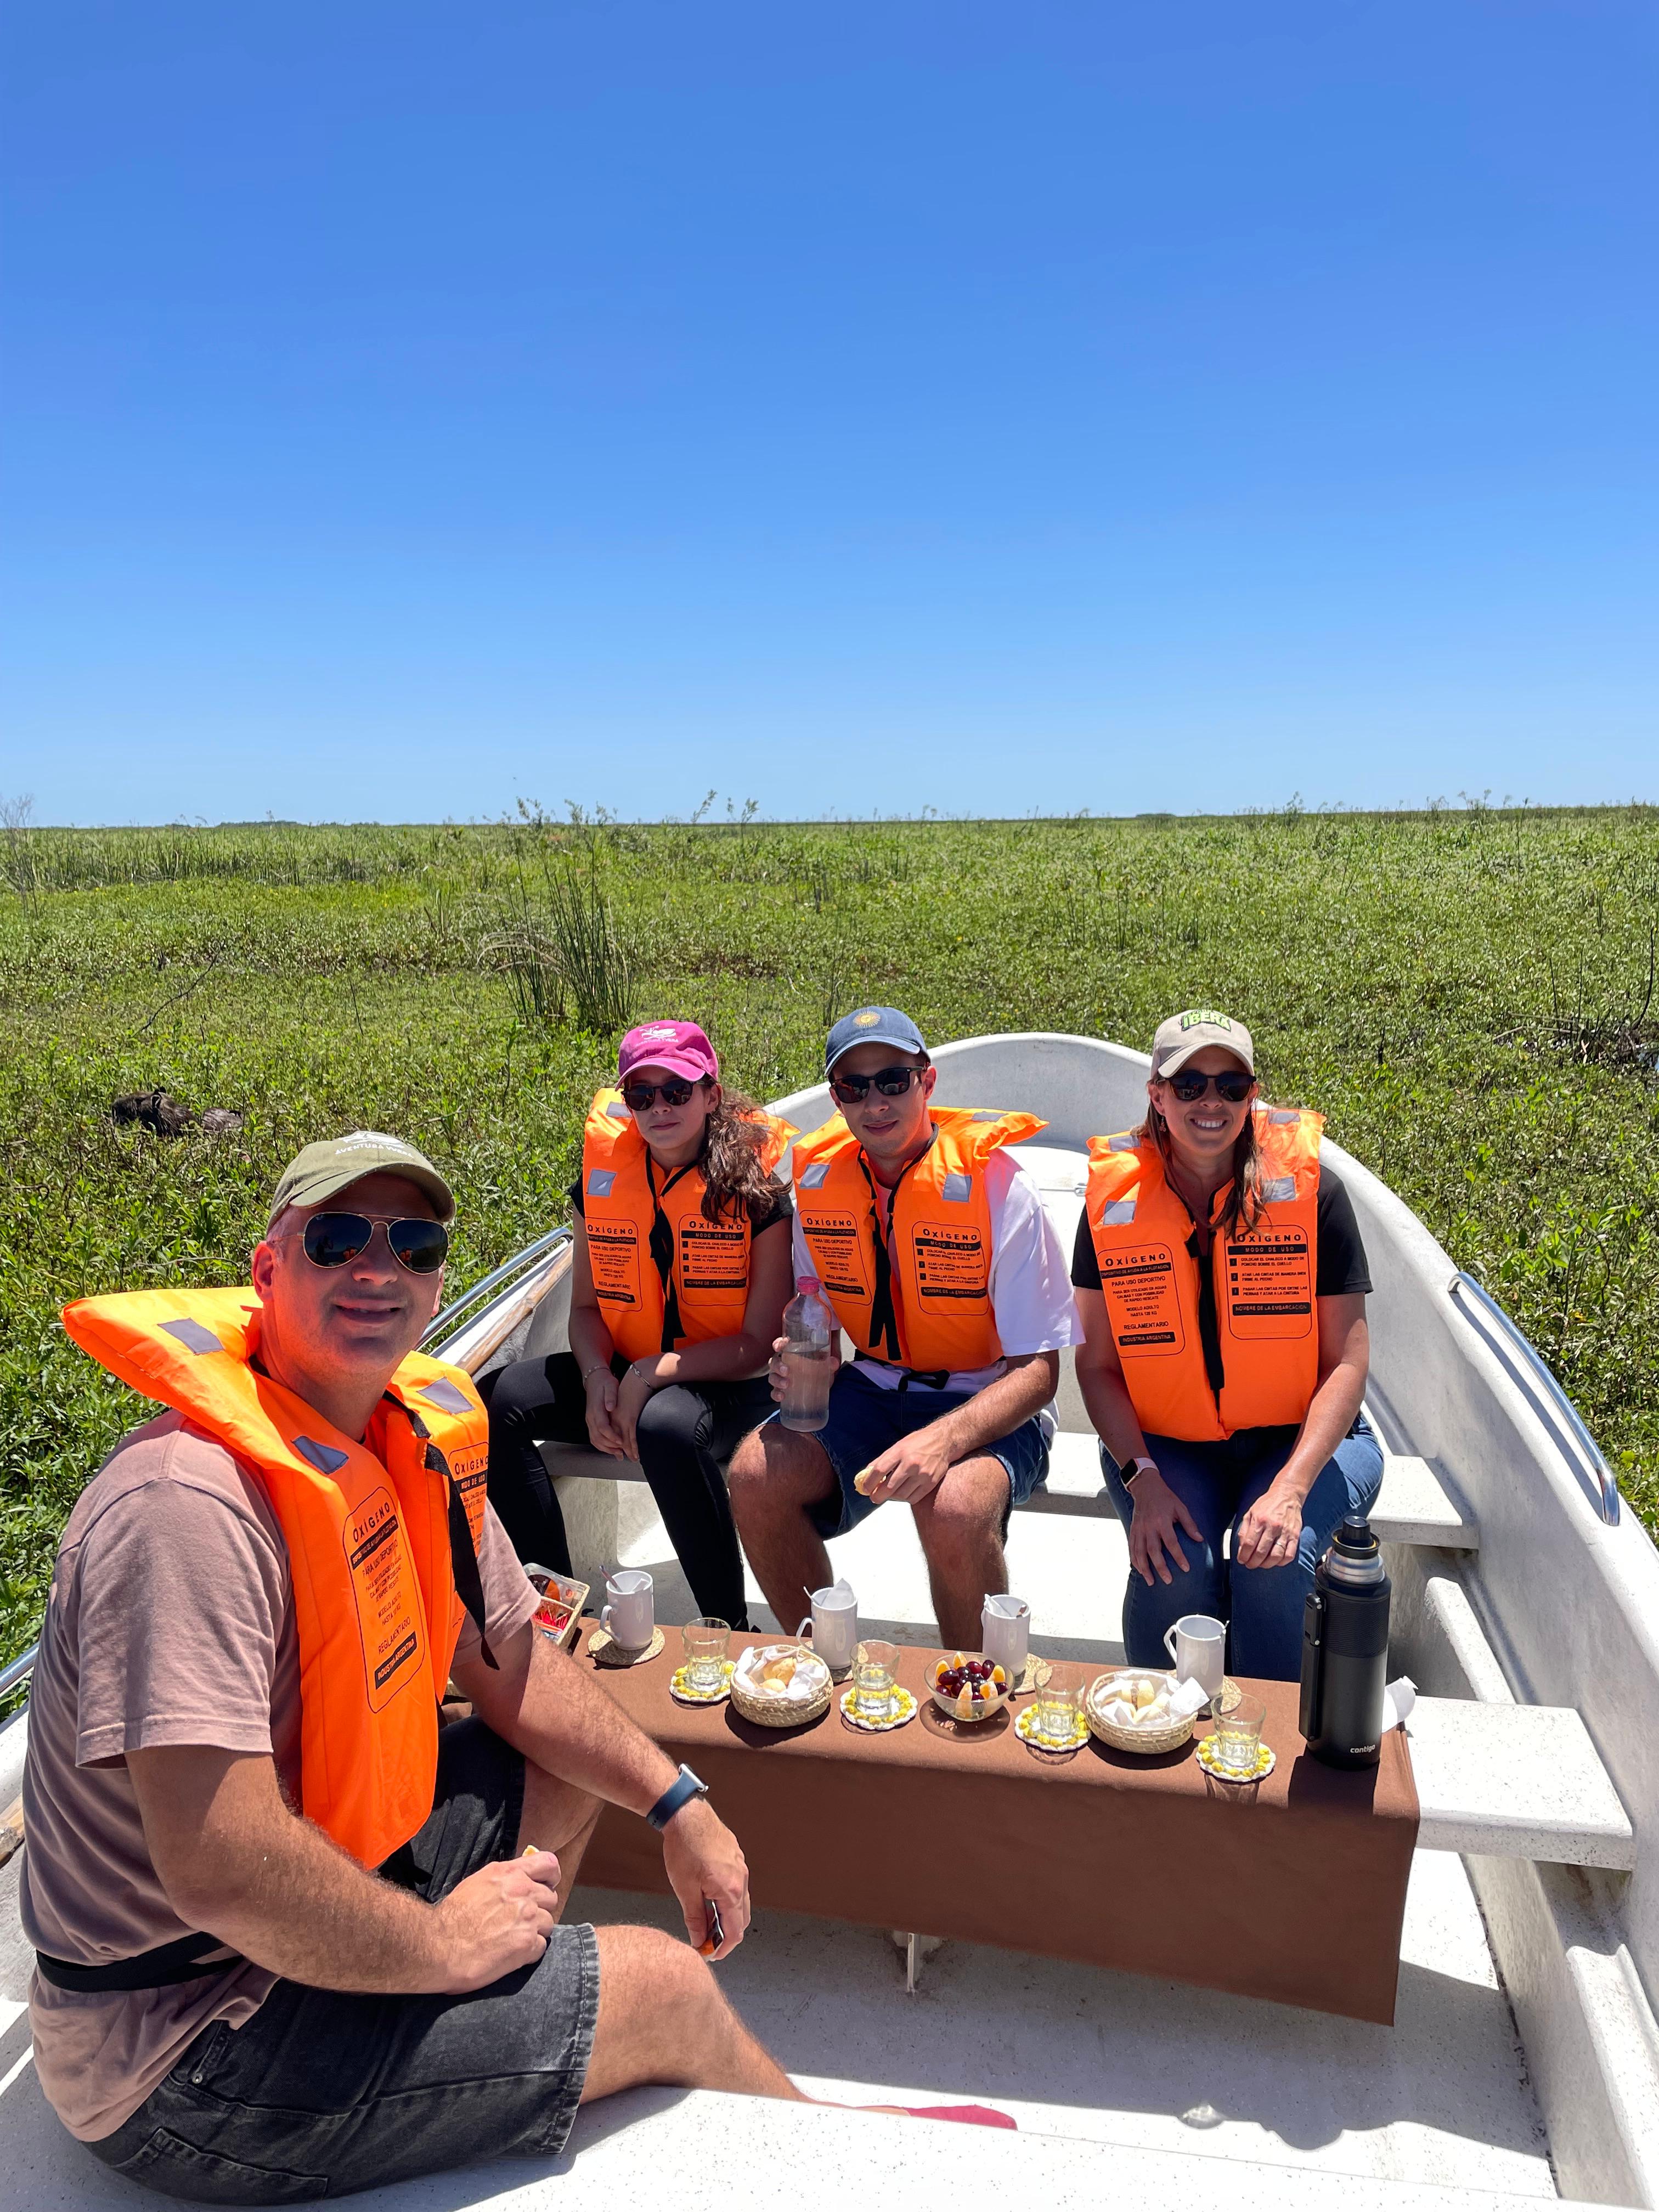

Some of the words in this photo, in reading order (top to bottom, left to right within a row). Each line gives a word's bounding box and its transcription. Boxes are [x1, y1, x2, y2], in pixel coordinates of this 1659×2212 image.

[335, 1143, 385, 1155] AVENTURA
[923, 1228, 977, 1240] OXÍGENO
[1105, 1253, 1166, 1267] OXÍGENO
[1137, 1276, 1166, 1284] DEPORTIVO
[1124, 1321, 1169, 1330] REGLAMENTARIO
[353, 1502, 390, 1543] OXÍGENO
[379, 1616, 410, 1654] REGLAMENTARIO
[1350, 1745, 1375, 1753] contigo
